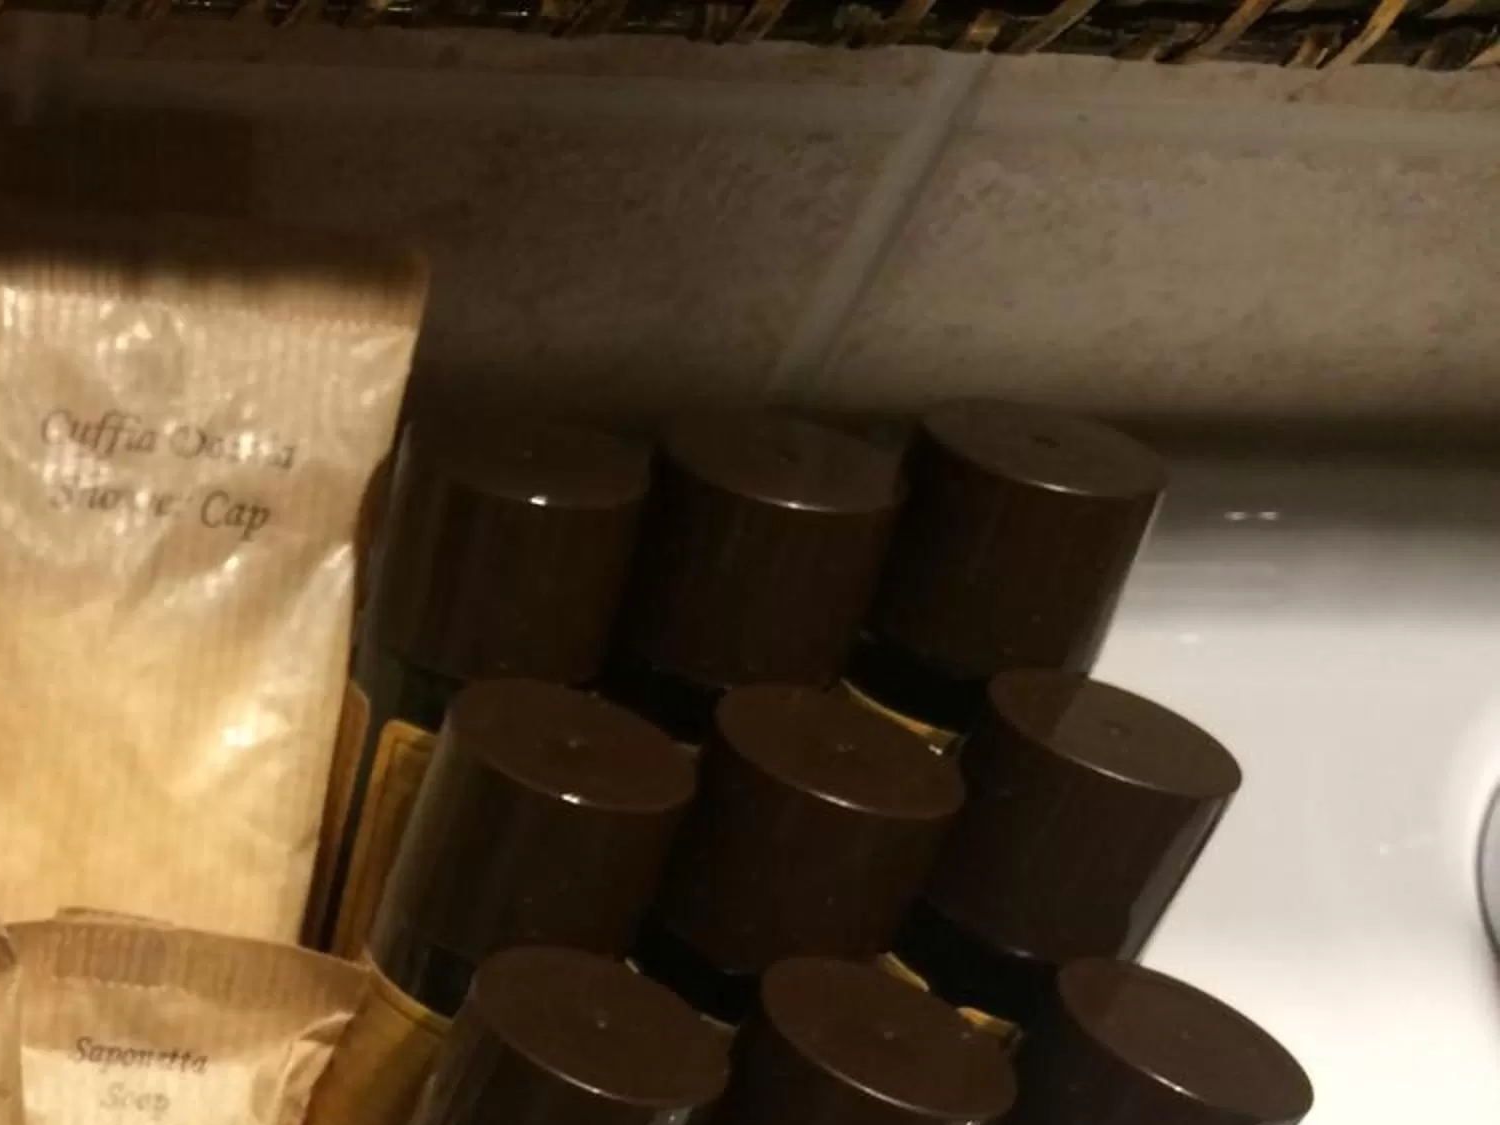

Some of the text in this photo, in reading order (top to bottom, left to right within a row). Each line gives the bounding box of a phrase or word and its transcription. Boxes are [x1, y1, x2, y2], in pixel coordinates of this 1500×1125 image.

[41, 407, 158, 461] Cuffia
[201, 488, 272, 542] Cap
[73, 1035, 208, 1076] Saponetta
